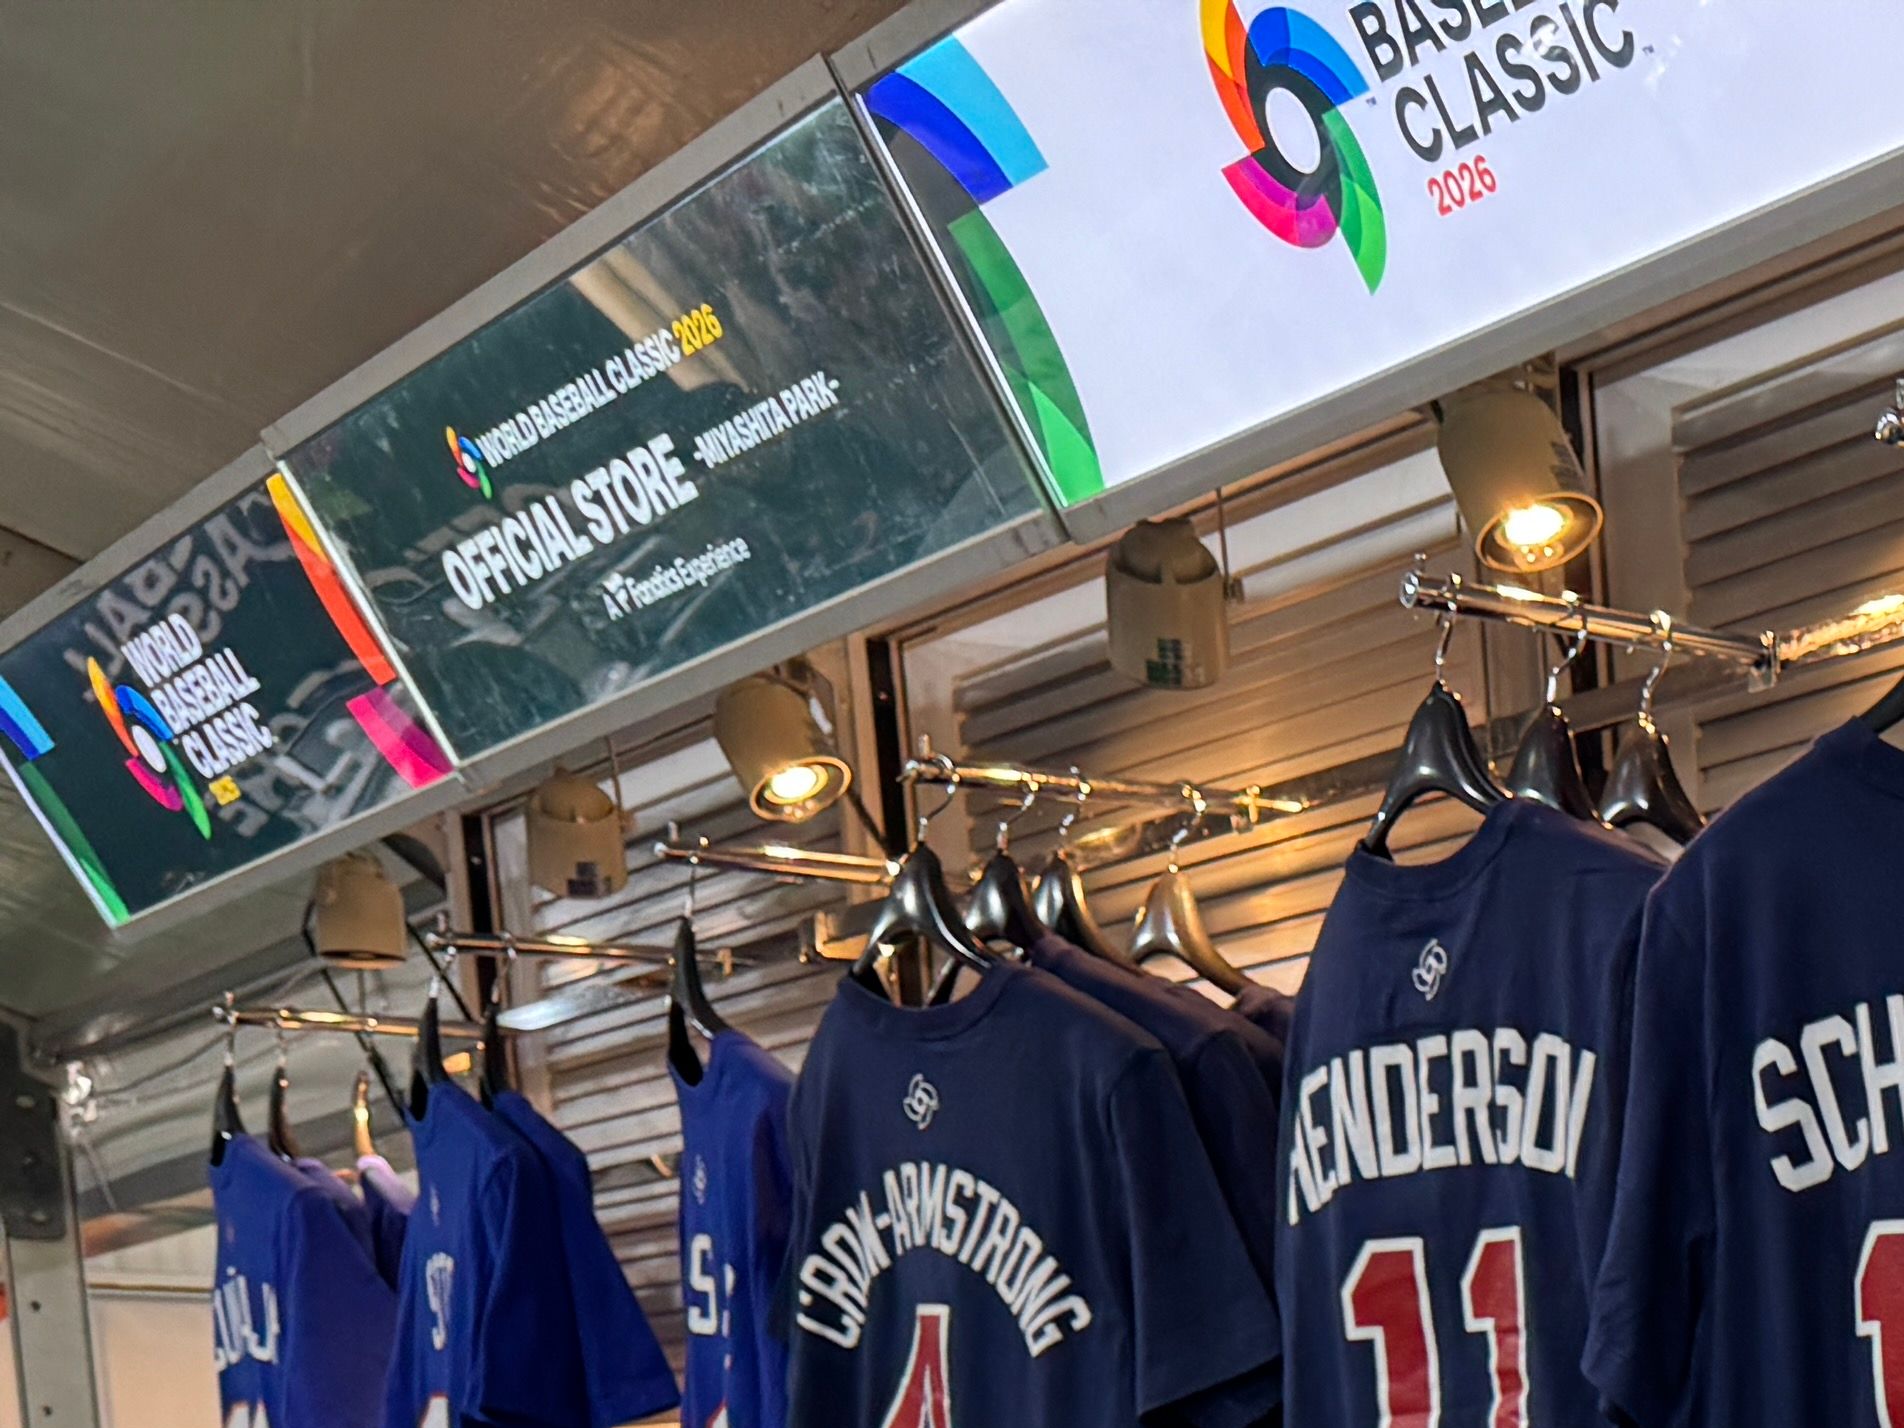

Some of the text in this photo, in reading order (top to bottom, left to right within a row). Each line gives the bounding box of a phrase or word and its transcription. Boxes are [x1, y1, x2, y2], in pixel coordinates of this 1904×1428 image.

[1395, 0, 1635, 163] CLASSIC
[1427, 155, 1497, 216] 2026
[475, 303, 724, 468] WORLD BASEBALL CLASSIC 2026
[442, 433, 699, 610] OFFICIAL STORE
[121, 612, 203, 688] WORLD
[151, 647, 261, 736] BASEBALL
[182, 702, 273, 780] CLASSIC
[797, 1160, 1092, 1358] CROW-ARMSTRONG
